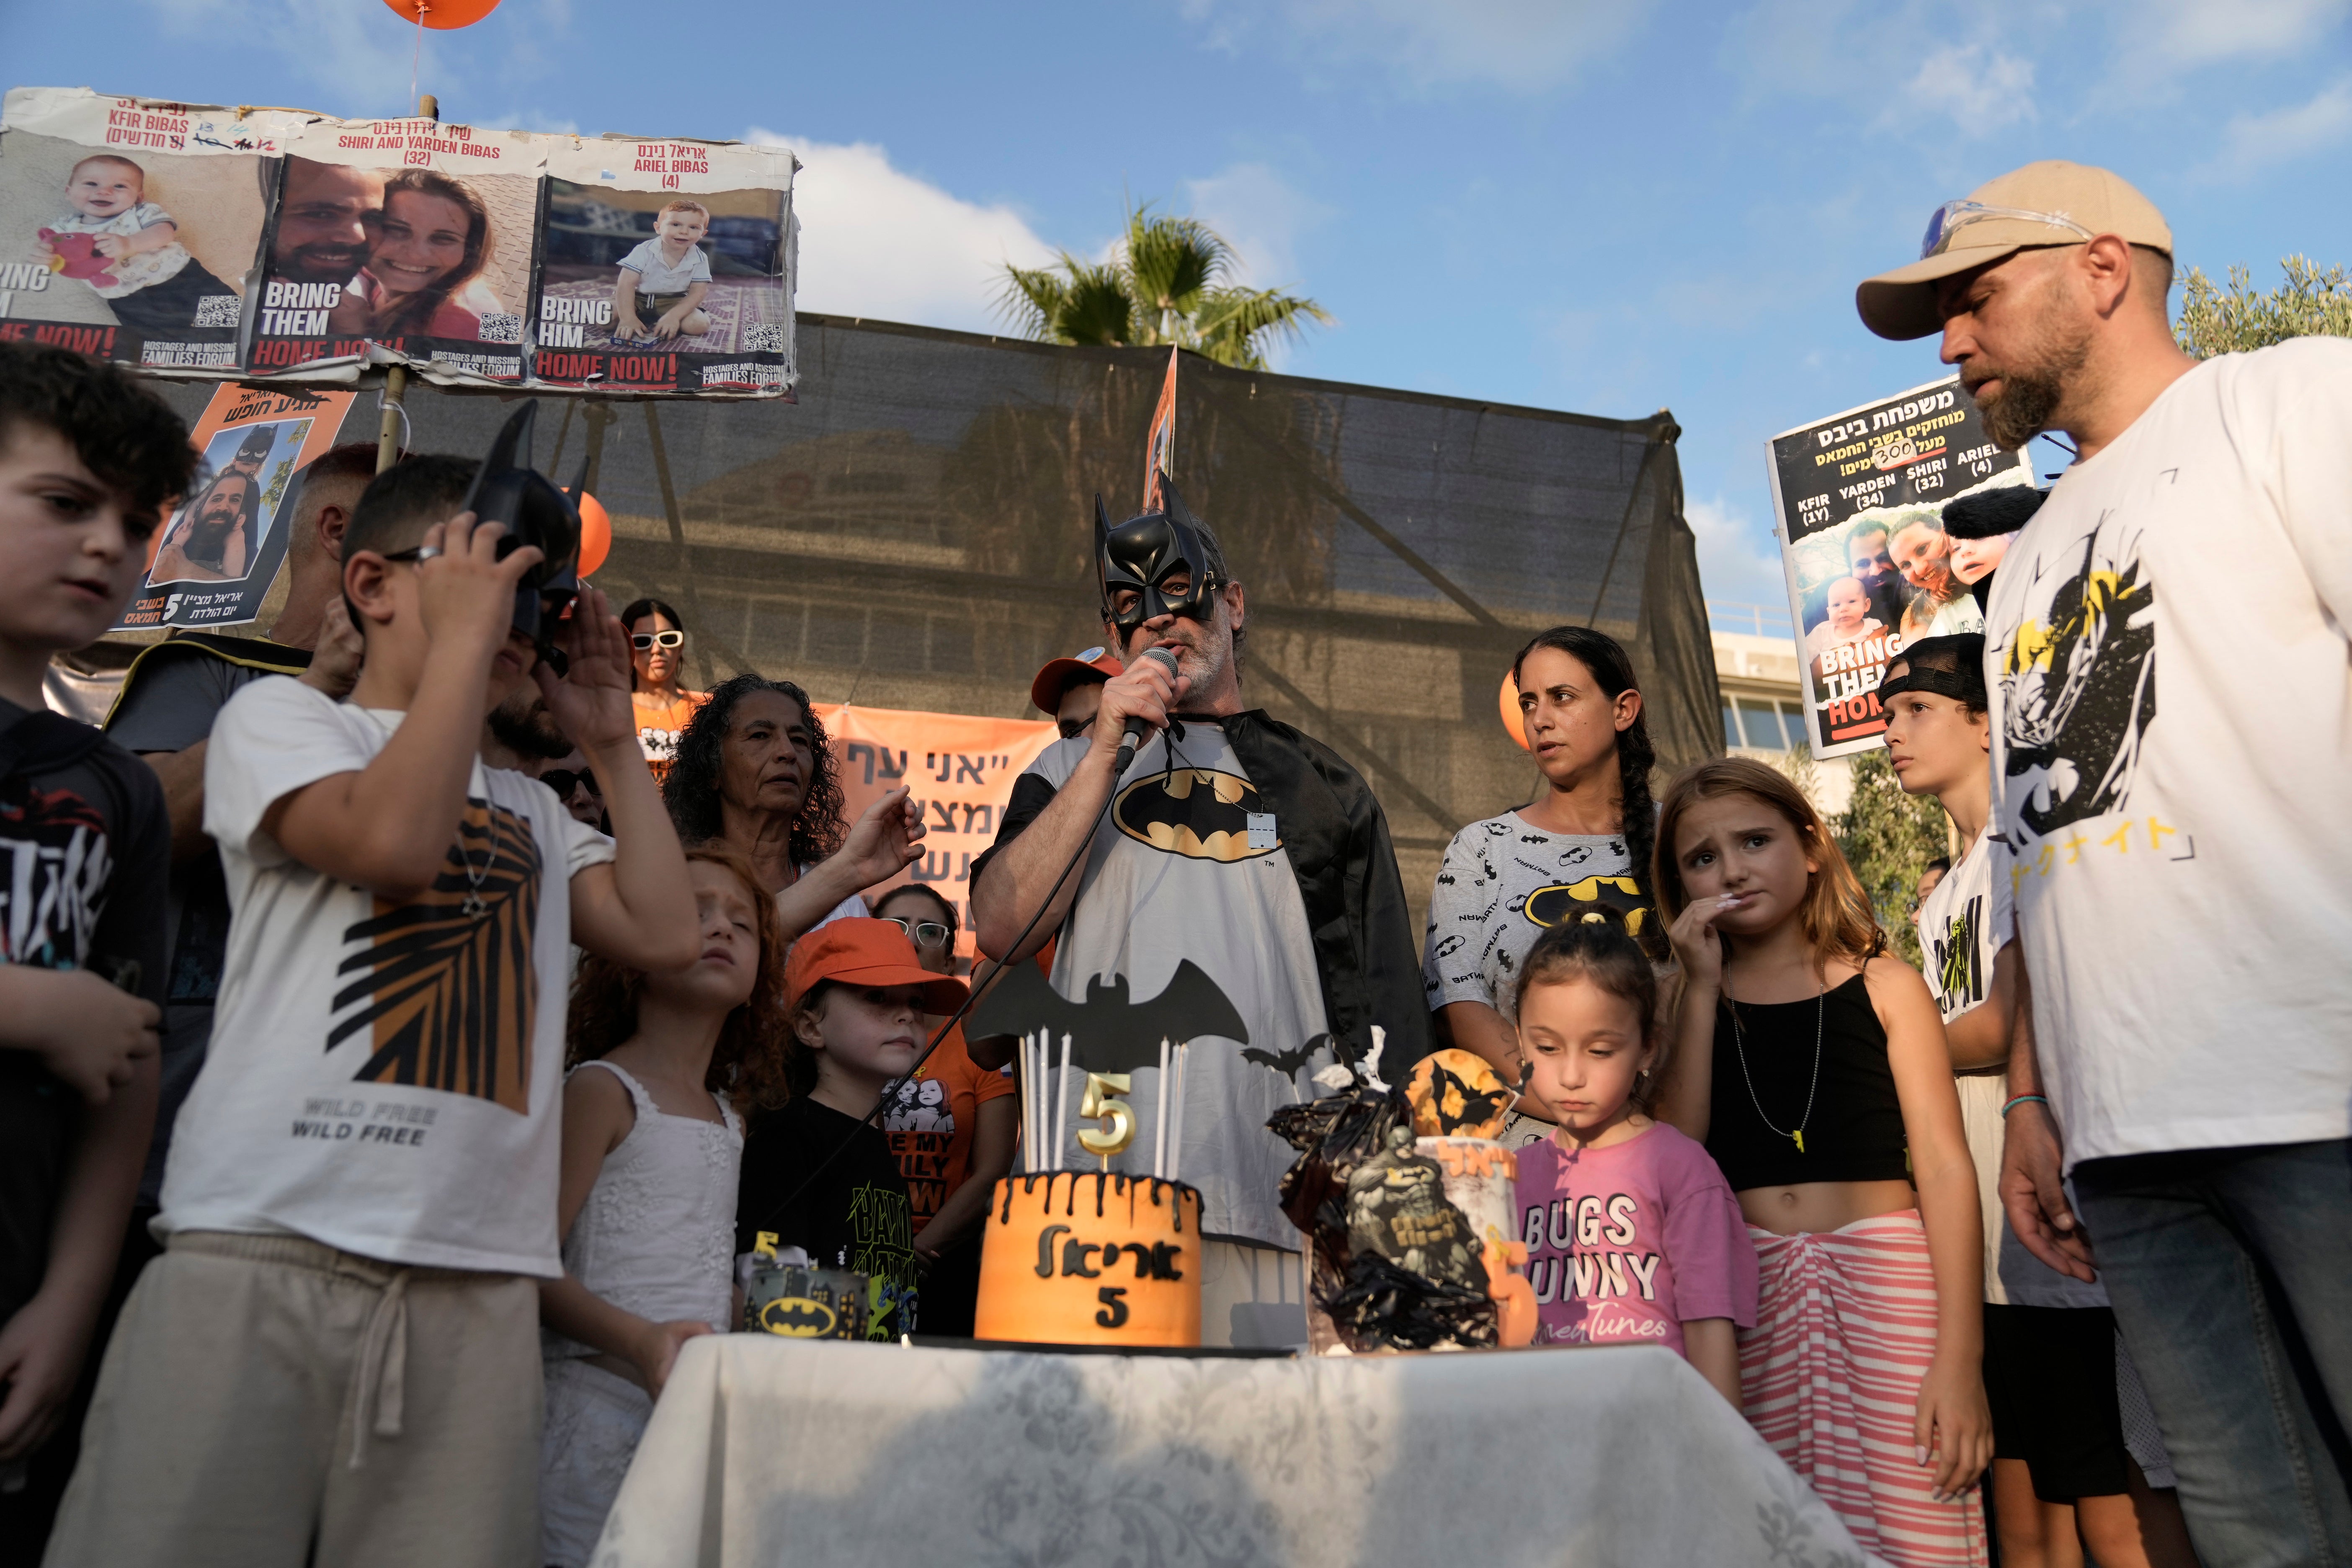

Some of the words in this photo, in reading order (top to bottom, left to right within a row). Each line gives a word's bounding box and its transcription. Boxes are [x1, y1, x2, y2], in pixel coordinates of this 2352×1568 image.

[108, 109, 141, 128] KFIR
[145, 115, 189, 133] BIBAS
[338, 135, 374, 149] SHIRI
[377, 136, 404, 149] AND
[408, 136, 458, 154] YARDEN
[461, 142, 500, 159] BIBAS
[404, 150, 431, 166] (32)
[638, 144, 665, 158] ביבס
[669, 144, 706, 160] אריאל
[634, 159, 668, 173] ARIEL
[671, 160, 709, 174] BIBAS
[662, 174, 679, 189] (4)
[0, 263, 50, 291] ING
[265, 281, 341, 309] BRING
[262, 309, 330, 335] THEM
[541, 295, 611, 325] BRING
[143, 340, 186, 352] HOSTAGES
[186, 343, 203, 353] AND
[203, 342, 237, 353] MISSING
[538, 321, 584, 348] HIM
[141, 351, 194, 366] FAMILIES
[196, 352, 236, 366] FORUM
[253, 340, 328, 366] HOME
[431, 350, 470, 363] HOSTAGES
[470, 355, 487, 364] AND
[487, 355, 521, 365] MISSING
[482, 363, 520, 377] FORUM
[536, 351, 603, 378] HOME
[610, 353, 677, 382] NOW!
[703, 364, 738, 374] HOSTAGES
[739, 363, 754, 371] AND
[703, 370, 748, 384] FAMILIES
[223, 400, 272, 423] חופש
[1872, 390, 1954, 431] משפחת
[1818, 419, 1869, 448] ביבס
[1906, 410, 1965, 438] מוחזקים
[1868, 429, 1904, 449] בשבי
[1916, 435, 1946, 453] מעל
[1815, 441, 1867, 467] החמאס
[1875, 442, 1911, 464] 300
[1798, 493, 1830, 513] KFIR
[1839, 473, 1896, 500] YARDEN
[1906, 457, 1948, 480] SHIRI
[1803, 506, 1830, 526] (1Y)
[1856, 490, 1884, 511] (34)
[1915, 472, 1944, 494] (32)
[1971, 459, 1993, 477] (4)
[135, 596, 165, 610] בשבי
[162, 593, 183, 621] 5
[183, 594, 212, 606] מציין
[214, 592, 243, 604] אריאל
[124, 611, 161, 624] חמאס
[189, 607, 221, 619] הולדת
[222, 606, 237, 616] יום
[1820, 633, 1904, 676] BRING
[848, 743, 908, 785] עף
[1514, 857, 1551, 877] BATMAN
[304, 1097, 365, 1117] WILD
[372, 1101, 439, 1126] FREE
[1076, 1072, 1137, 1156] 5
[291, 1119, 353, 1140] WILD
[359, 1124, 427, 1147] FREE
[916, 1134, 954, 1152] MY
[1523, 1192, 1638, 1254] BUGS
[1529, 1252, 1661, 1305] UNNY
[1095, 1287, 1130, 1328] 5
[1586, 1301, 1668, 1342] Tunes
